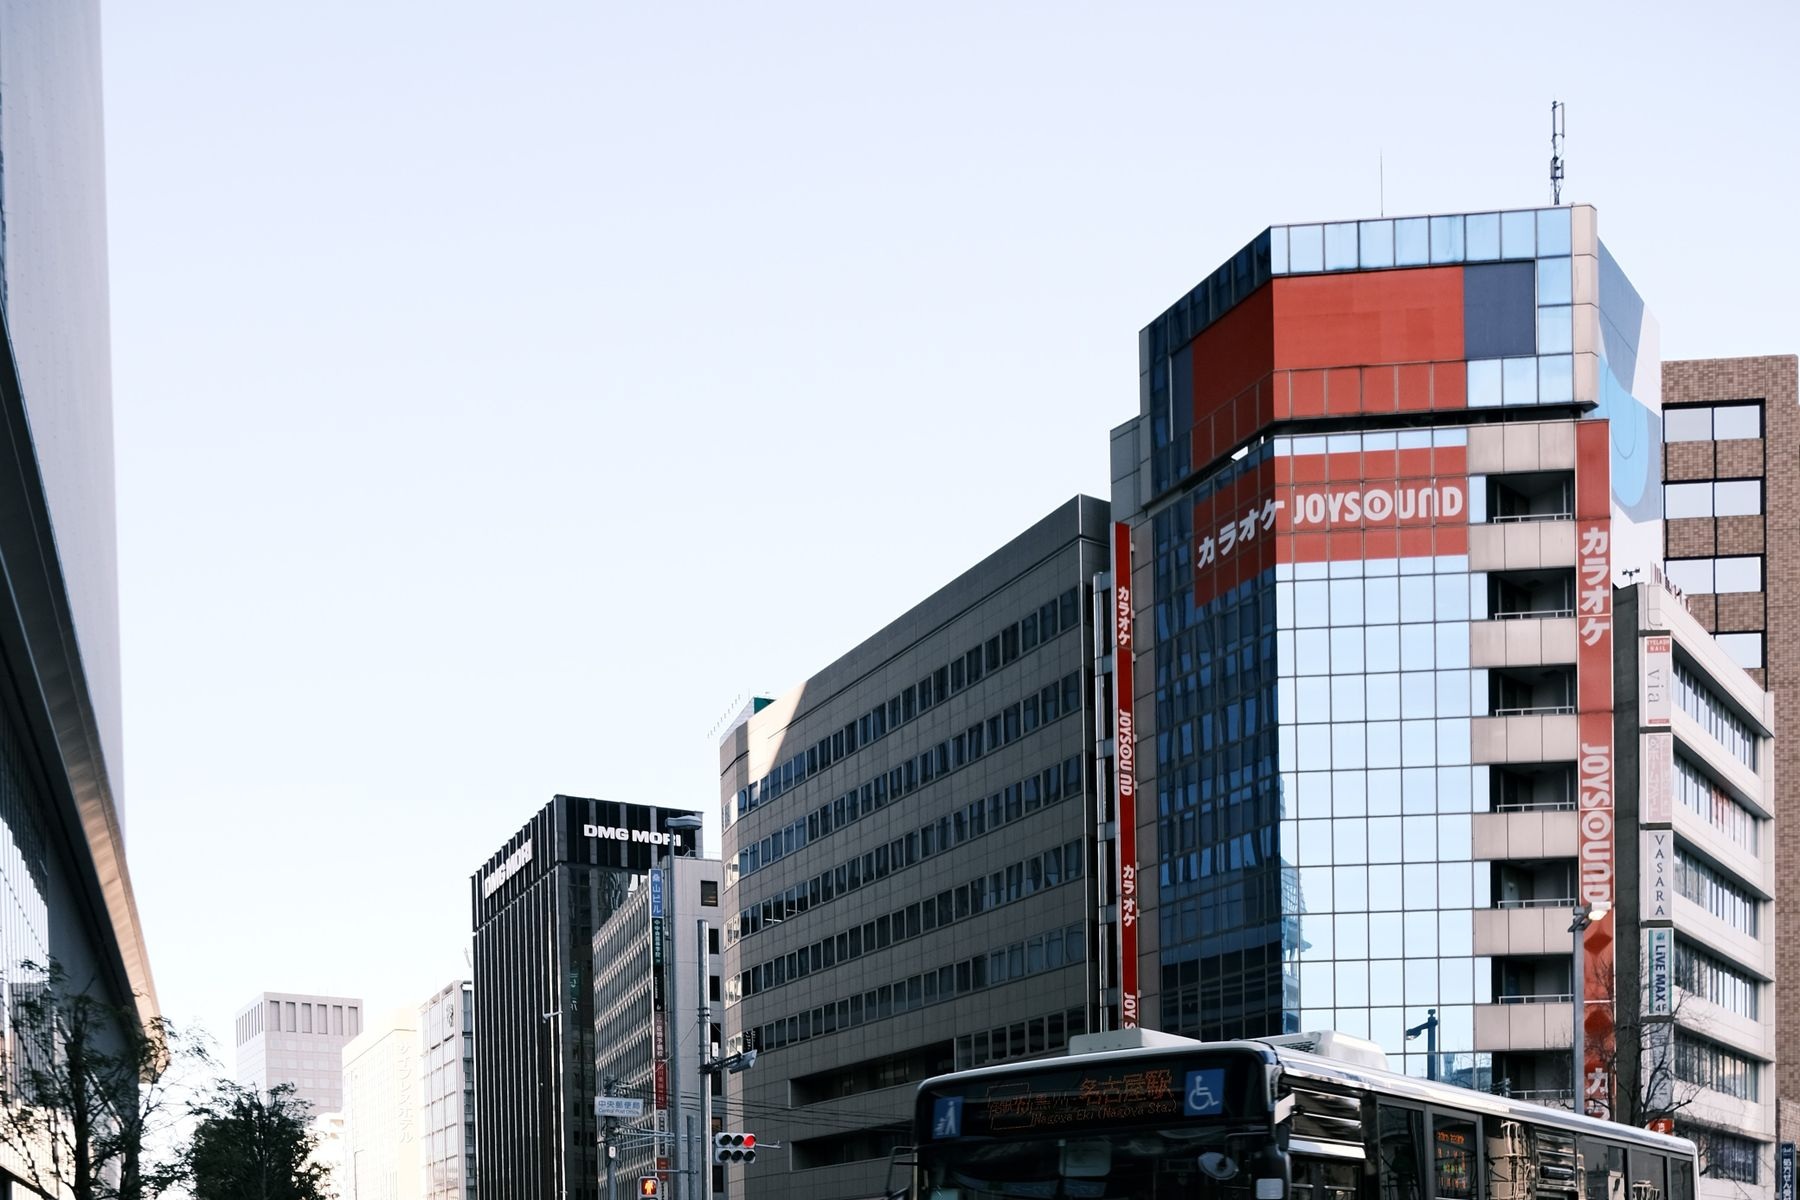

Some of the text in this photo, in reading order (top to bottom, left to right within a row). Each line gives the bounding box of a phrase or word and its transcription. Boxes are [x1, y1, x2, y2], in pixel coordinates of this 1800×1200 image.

[1197, 486, 1463, 569] カラオケ JOYSOUND
[1117, 586, 1131, 646] カラオケ
[1580, 527, 1610, 647] カラオケ
[1119, 709, 1133, 796] JOYSOUND
[584, 824, 682, 847] DMG MORI
[1581, 743, 1611, 905] JOYSOUND
[485, 838, 533, 898] DMG MORI
[1123, 865, 1136, 927] カラオケ
[1655, 834, 1665, 916] VASARA
[1079, 1069, 1175, 1105] 名古屋駅
